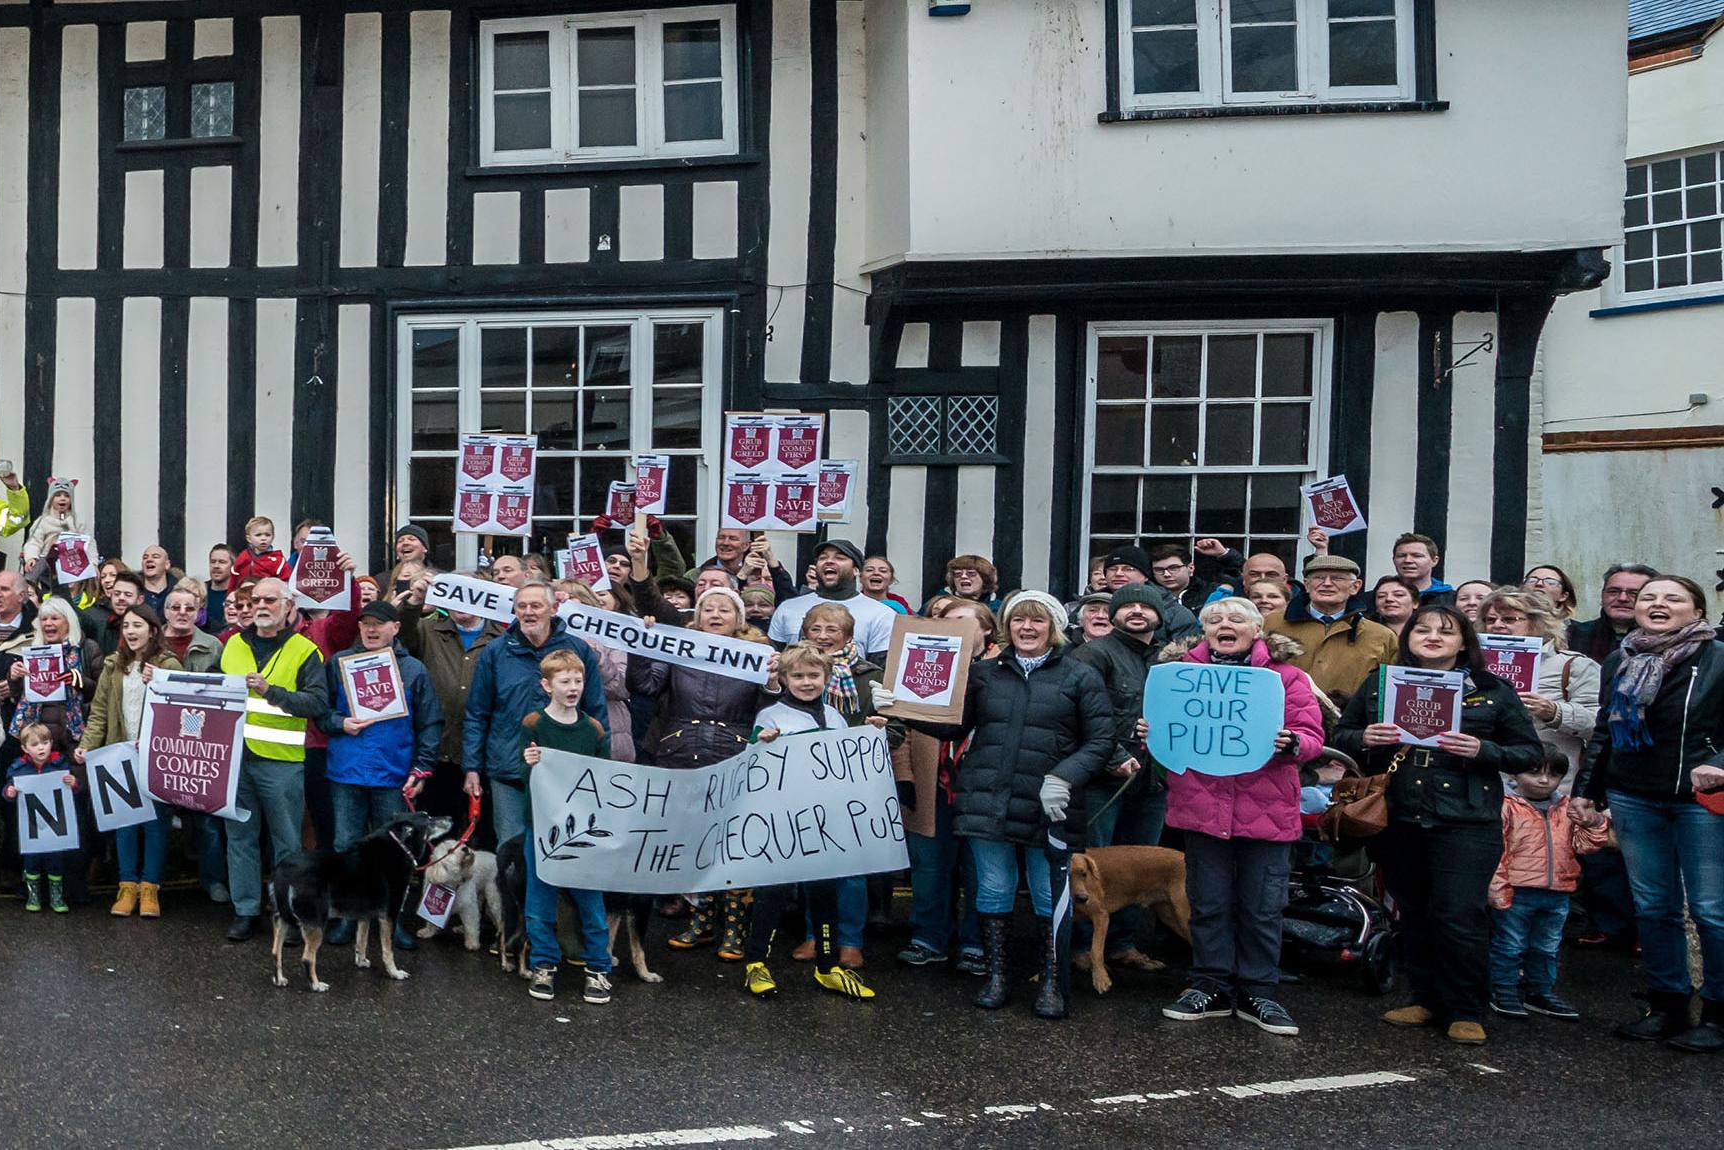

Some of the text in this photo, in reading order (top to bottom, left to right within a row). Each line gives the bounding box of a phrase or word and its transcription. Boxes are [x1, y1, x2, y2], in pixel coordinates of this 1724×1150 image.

[776, 500, 811, 511] SAVE
[1318, 500, 1343, 511] PINTS
[1323, 507, 1342, 515] NOT
[498, 508, 526, 518] SAVE
[1317, 510, 1355, 523] POUNDS
[305, 561, 336, 570] GRUB
[308, 570, 333, 578] NOT
[301, 578, 340, 587] GREED
[433, 580, 498, 612] SAVE
[567, 612, 695, 659] CHEQUER
[706, 644, 764, 673] INN
[914, 661, 944, 671] PINTS
[1487, 663, 1522, 674] GRUB
[30, 671, 58, 682] SAVE
[916, 670, 939, 678] NOT
[905, 675, 948, 687] POUNDS
[1171, 667, 1253, 695] SAVE
[356, 682, 393, 698] SAVE
[1183, 698, 1248, 722] OUR
[1405, 699, 1442, 710] GRUB
[1409, 708, 1438, 718] NOT
[1400, 716, 1445, 727] GREED
[1168, 722, 1250, 757] PUB
[151, 735, 229, 761] COMMUNITY
[155, 754, 220, 779] COMES
[162, 773, 212, 796] FIRST
[566, 767, 673, 818] ASH
[704, 745, 789, 813] RUGBY
[628, 828, 685, 873] THE
[695, 803, 846, 872] CHEQUER
